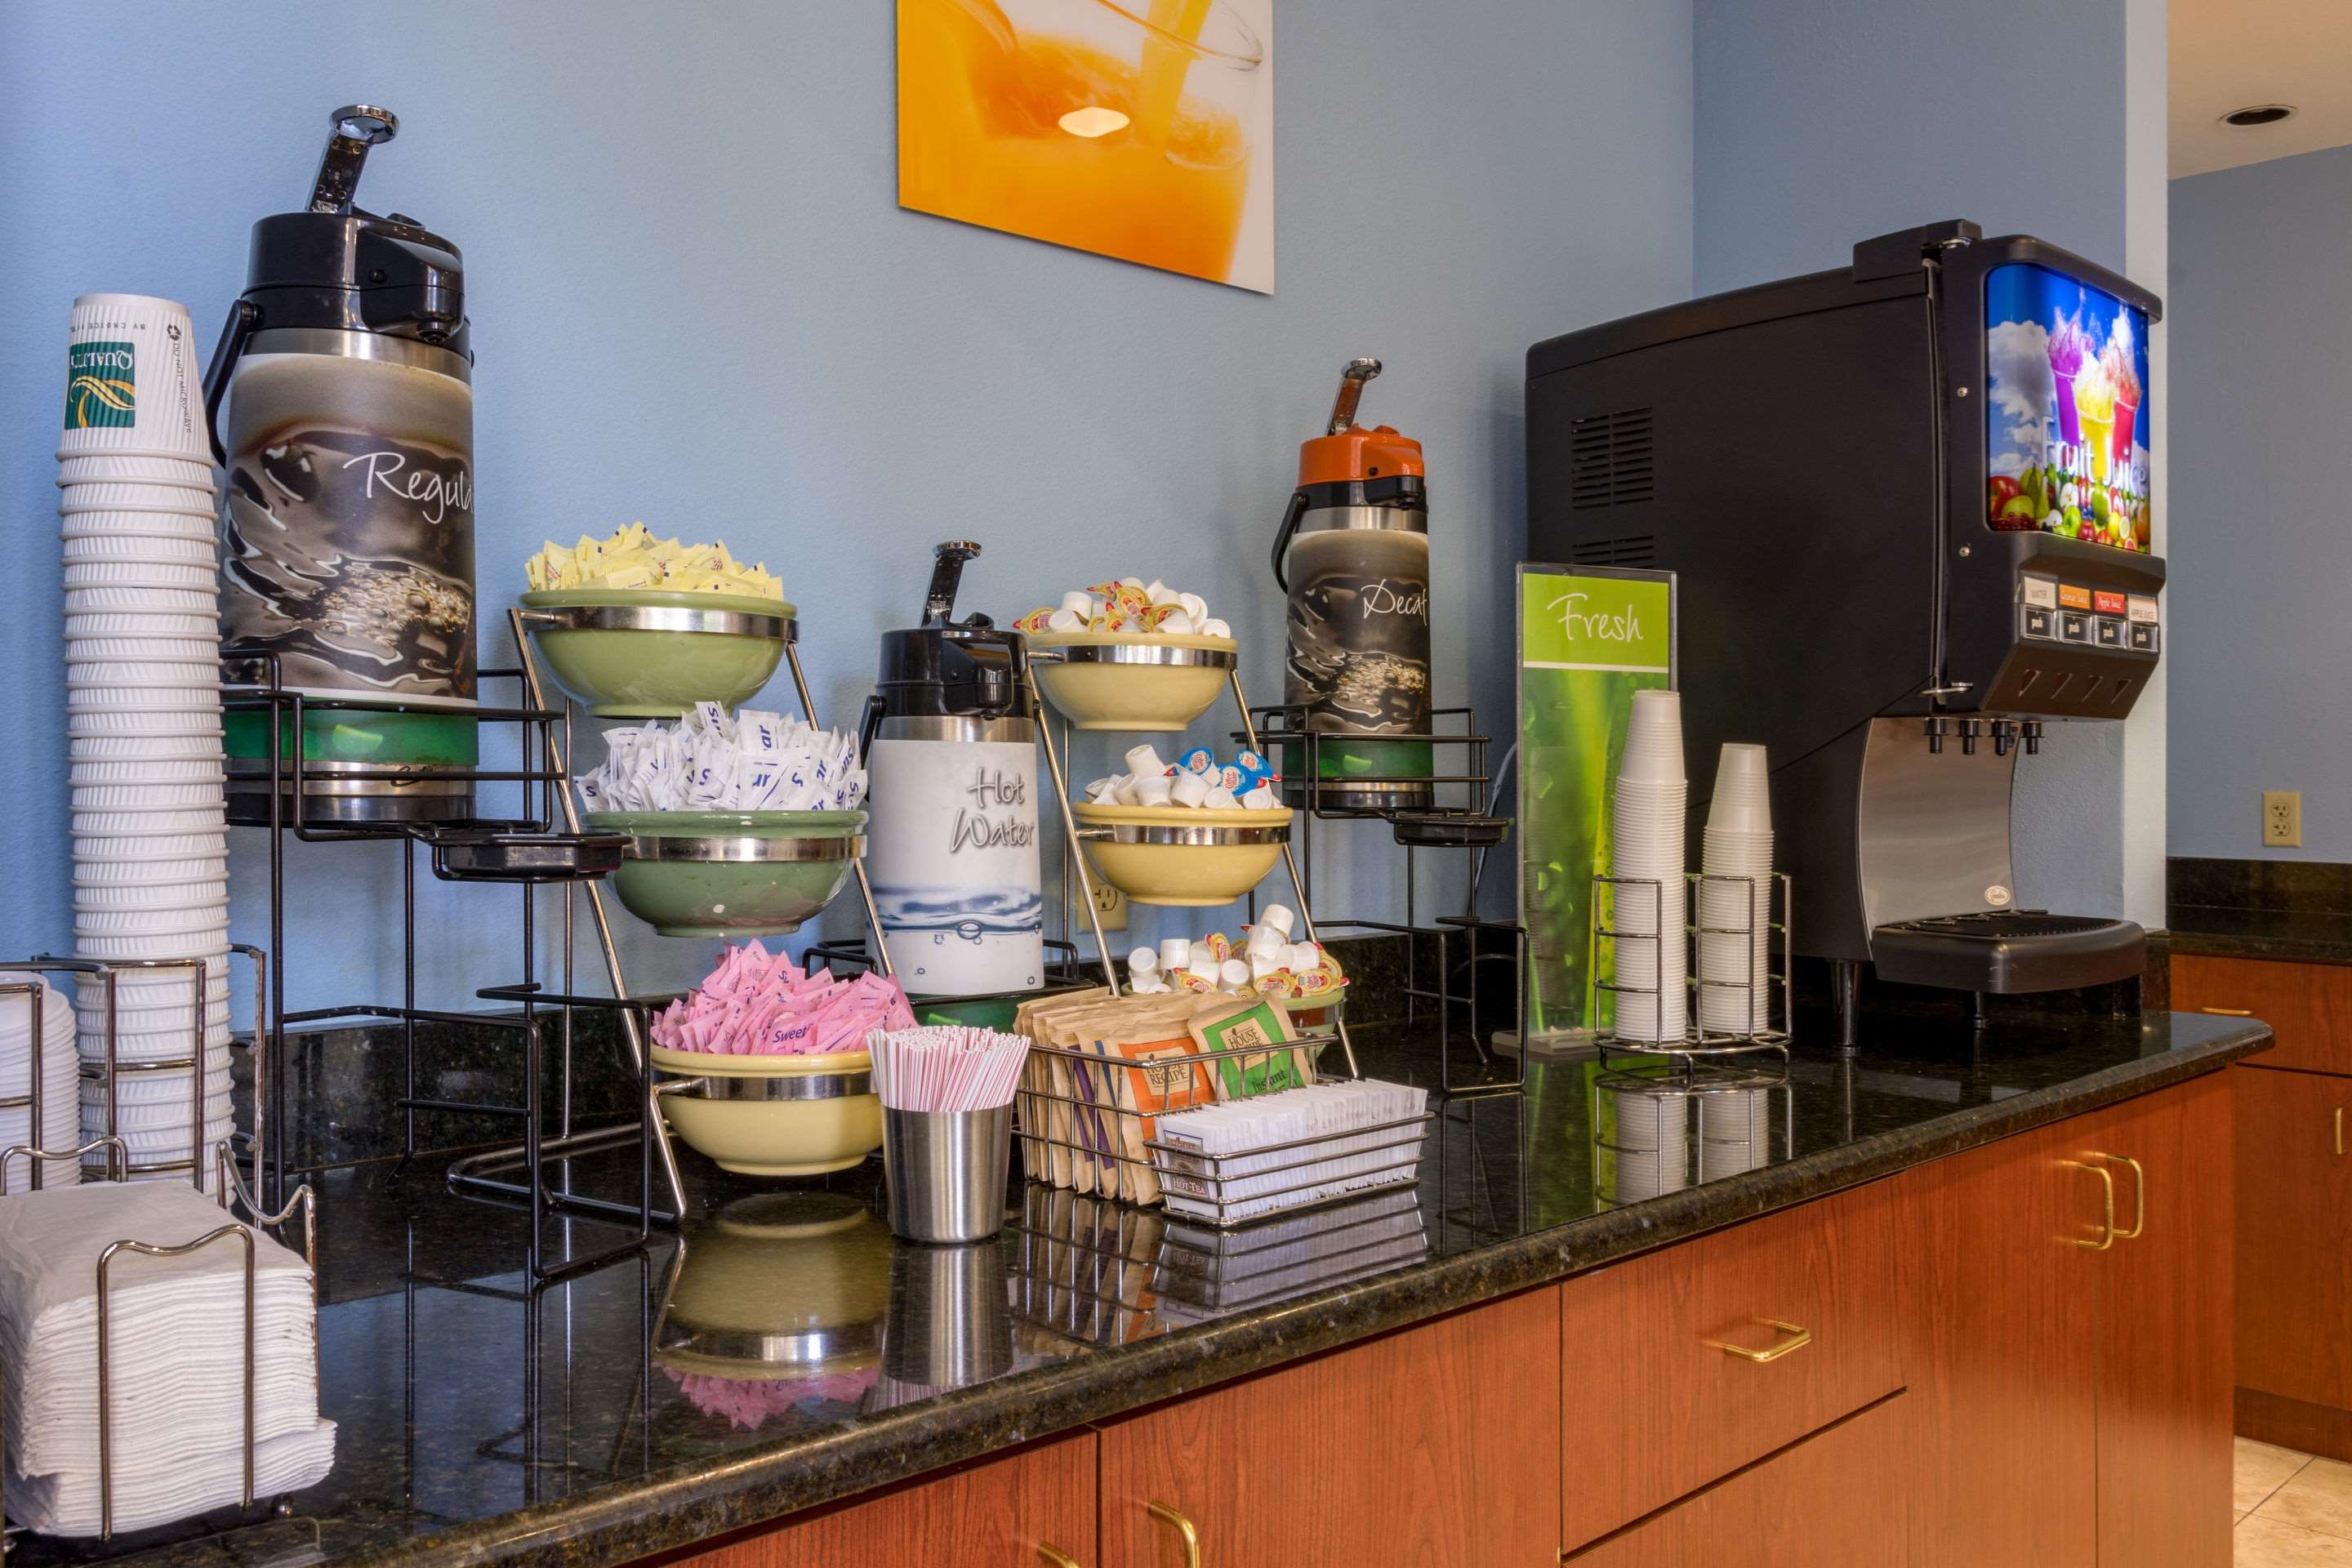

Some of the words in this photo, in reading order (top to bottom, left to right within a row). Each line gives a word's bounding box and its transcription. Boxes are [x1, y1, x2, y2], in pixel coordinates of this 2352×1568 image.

[2042, 415, 2096, 484] Fruit
[2102, 433, 2146, 500] Juice
[1546, 593, 1643, 643] Fresh
[967, 766, 1026, 808] Hot
[948, 807, 1036, 854] Water
[1228, 1028, 1261, 1050] HOUSE
